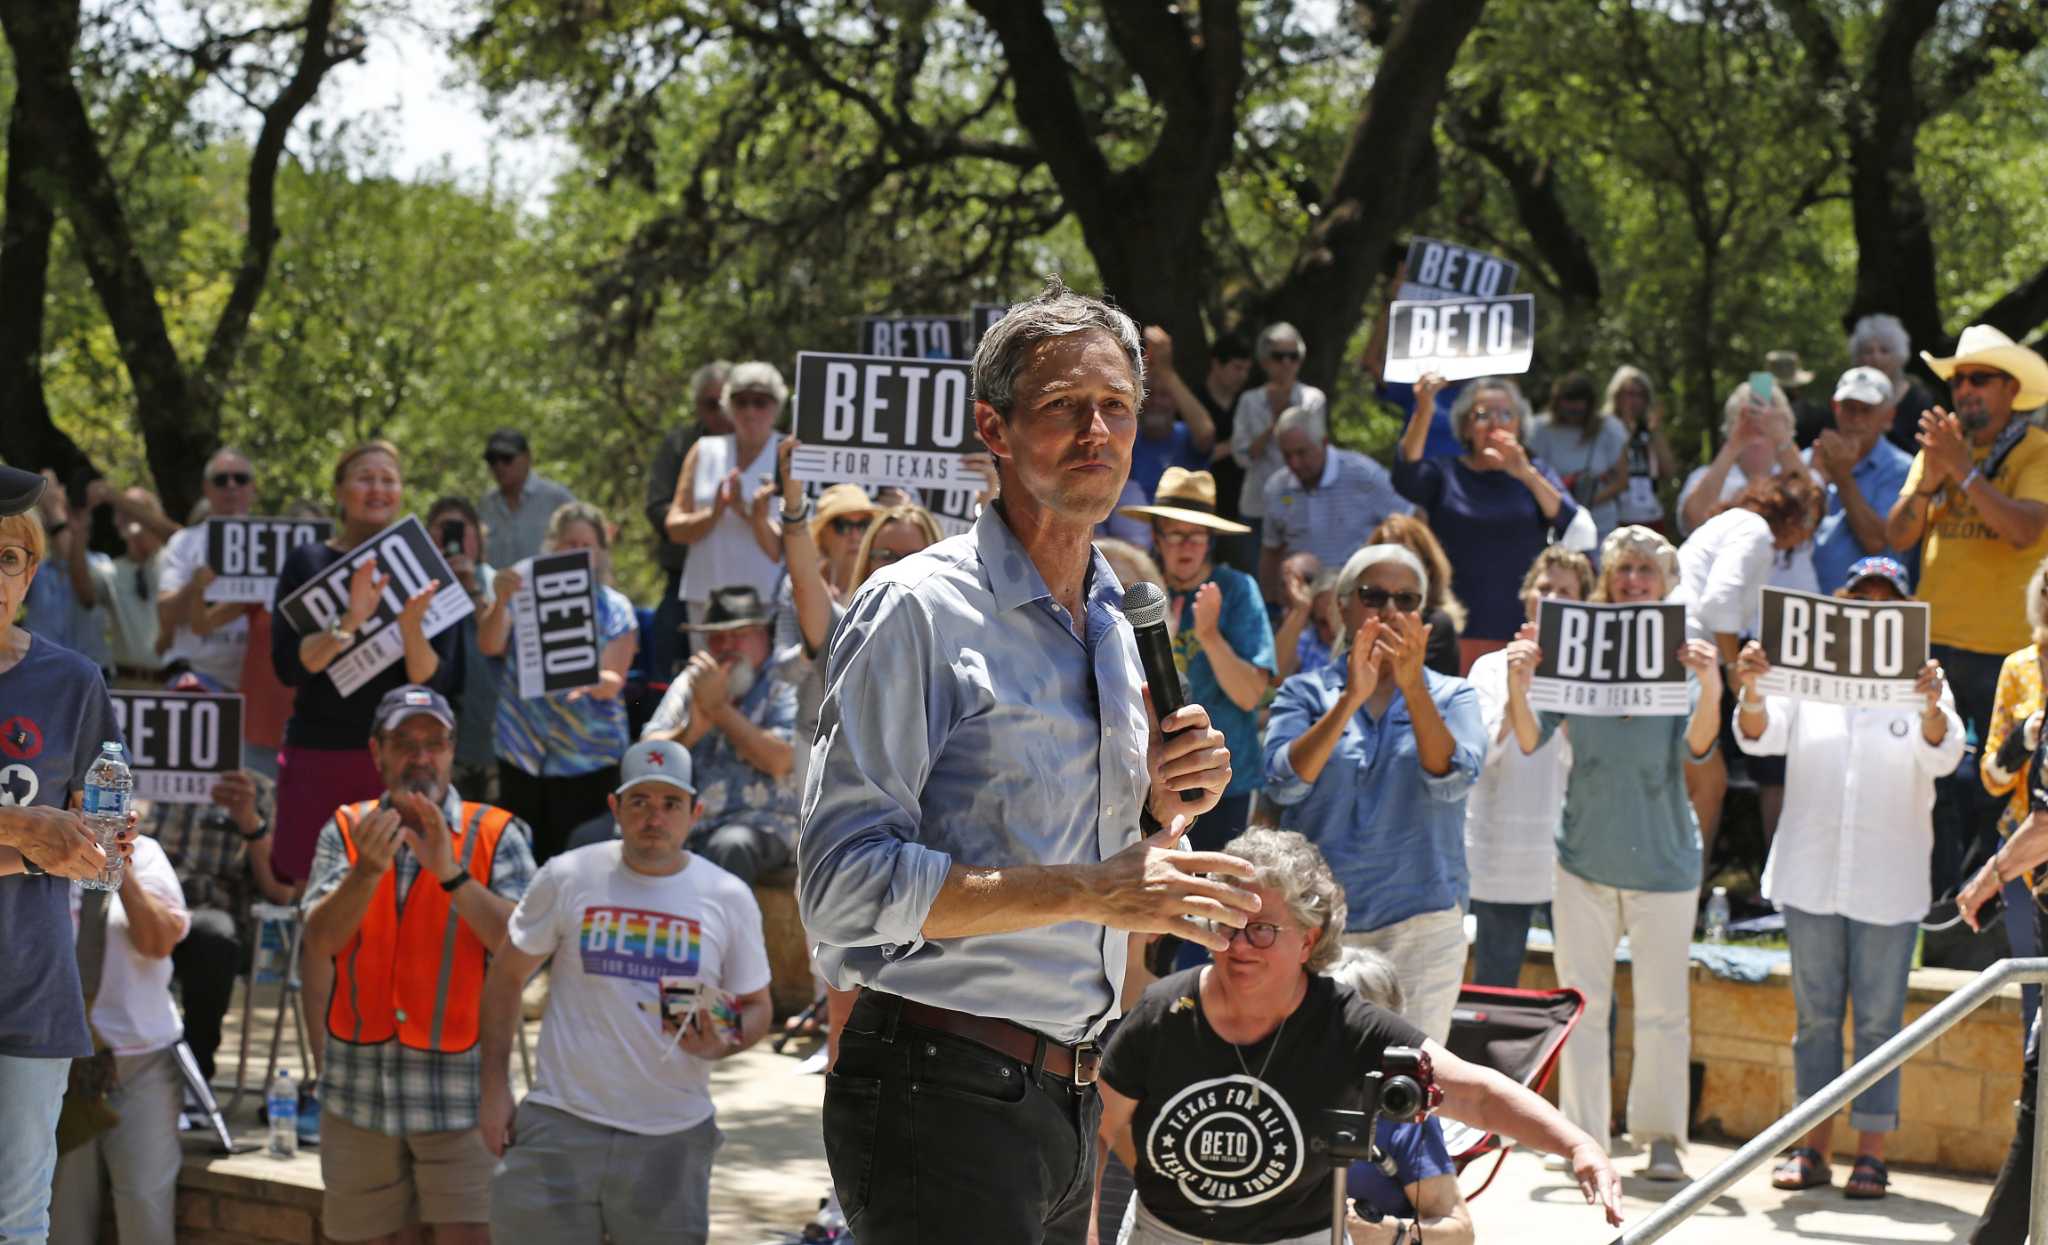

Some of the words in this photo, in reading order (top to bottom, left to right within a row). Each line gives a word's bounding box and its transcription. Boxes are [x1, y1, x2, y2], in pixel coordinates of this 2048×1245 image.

[1418, 243, 1503, 298] BETO
[1408, 302, 1514, 357] BETO
[822, 362, 966, 447] BETO
[832, 452, 870, 474] FOR
[884, 454, 948, 479] TEXAS
[535, 569, 596, 675] BETO
[1557, 608, 1665, 679] BETO
[1780, 596, 1904, 677] BETO
[1564, 685, 1597, 705] FOR
[1607, 686, 1653, 705] TEXAS
[1789, 674, 1821, 693] FOR
[1834, 681, 1891, 701] TEXAS
[152, 775, 207, 794] TEXAS
[587, 911, 690, 964] BETO
[1168, 1092, 1217, 1130] TEXAS
[1225, 1089, 1257, 1110] FOR
[1257, 1107, 1285, 1138] ALL
[1200, 1130, 1248, 1157] BETO
[1161, 1151, 1199, 1182] TEXAS
[1199, 1176, 1237, 1198] PARA
[1243, 1159, 1286, 1194] TODOS
